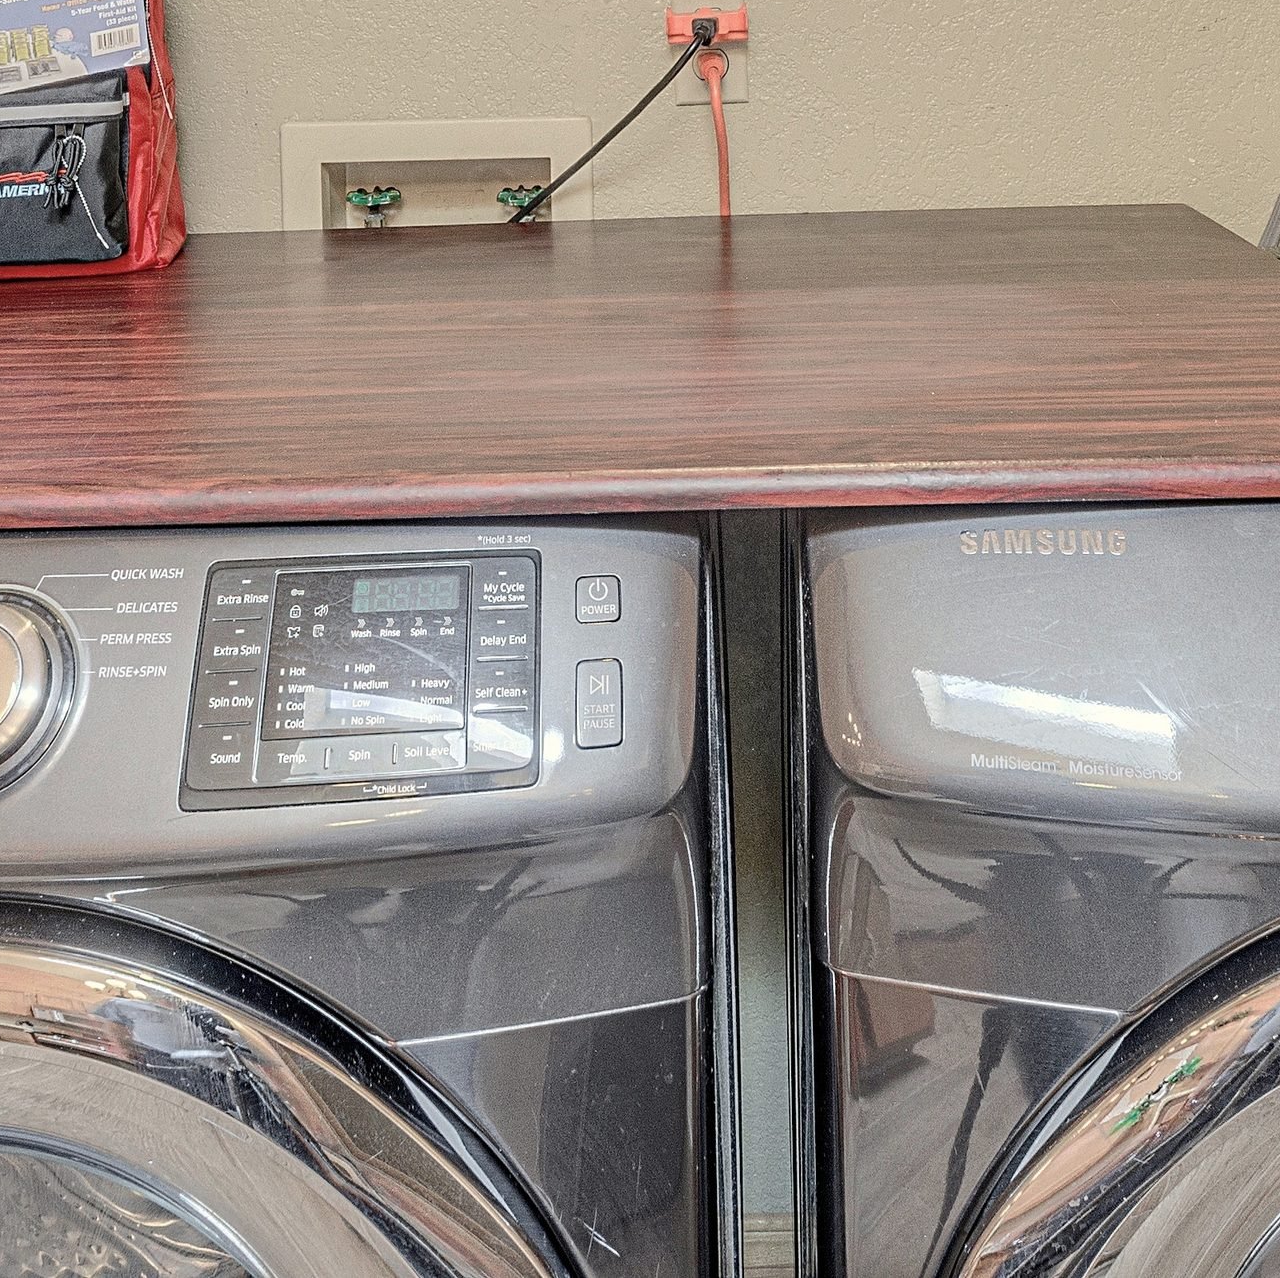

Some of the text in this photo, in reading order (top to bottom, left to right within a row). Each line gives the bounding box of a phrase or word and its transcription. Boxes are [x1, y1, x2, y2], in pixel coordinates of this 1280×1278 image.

[99, 8, 127, 19] First-Aid
[960, 529, 1128, 556] SAMSUNG
[110, 567, 184, 580] QUICK WASH
[483, 581, 525, 594] My Cycle
[217, 592, 269, 604] Extra Rinse
[116, 602, 178, 614] DELICATES
[581, 604, 616, 615] POWER
[99, 633, 172, 645] PERM PRESS
[351, 626, 455, 639] Wash Rinse Spin End
[480, 634, 527, 648] Delay End
[213, 644, 261, 658] Extra Spin
[98, 666, 167, 678] RINSE+SPIN
[289, 662, 375, 677] Hot High
[287, 677, 450, 694] Warm Medium Heavy
[208, 695, 254, 710] Spin Only
[583, 704, 616, 715] START
[583, 718, 615, 729] PAUSE
[210, 752, 240, 764] Sound
[1069, 760, 1183, 782] MoistureSensor
